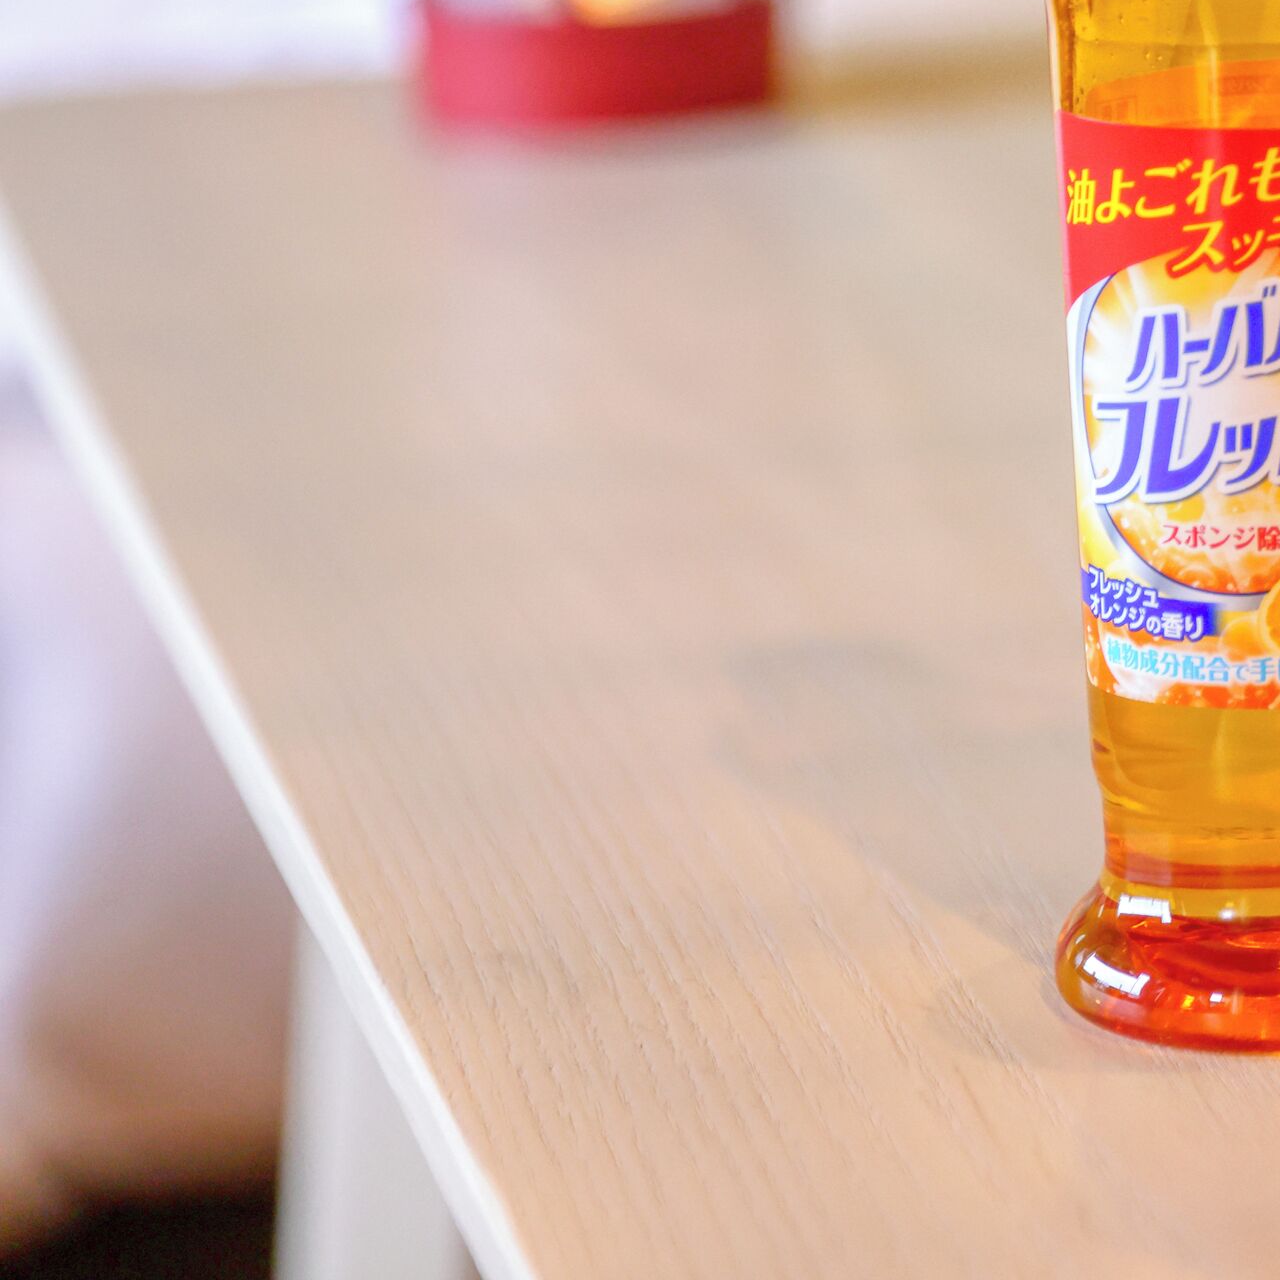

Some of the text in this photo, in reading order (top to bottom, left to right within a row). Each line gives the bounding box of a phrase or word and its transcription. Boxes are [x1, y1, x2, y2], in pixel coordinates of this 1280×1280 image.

[1087, 567, 1160, 611] フレッシュ
[1088, 596, 1206, 640] オレンジの香り
